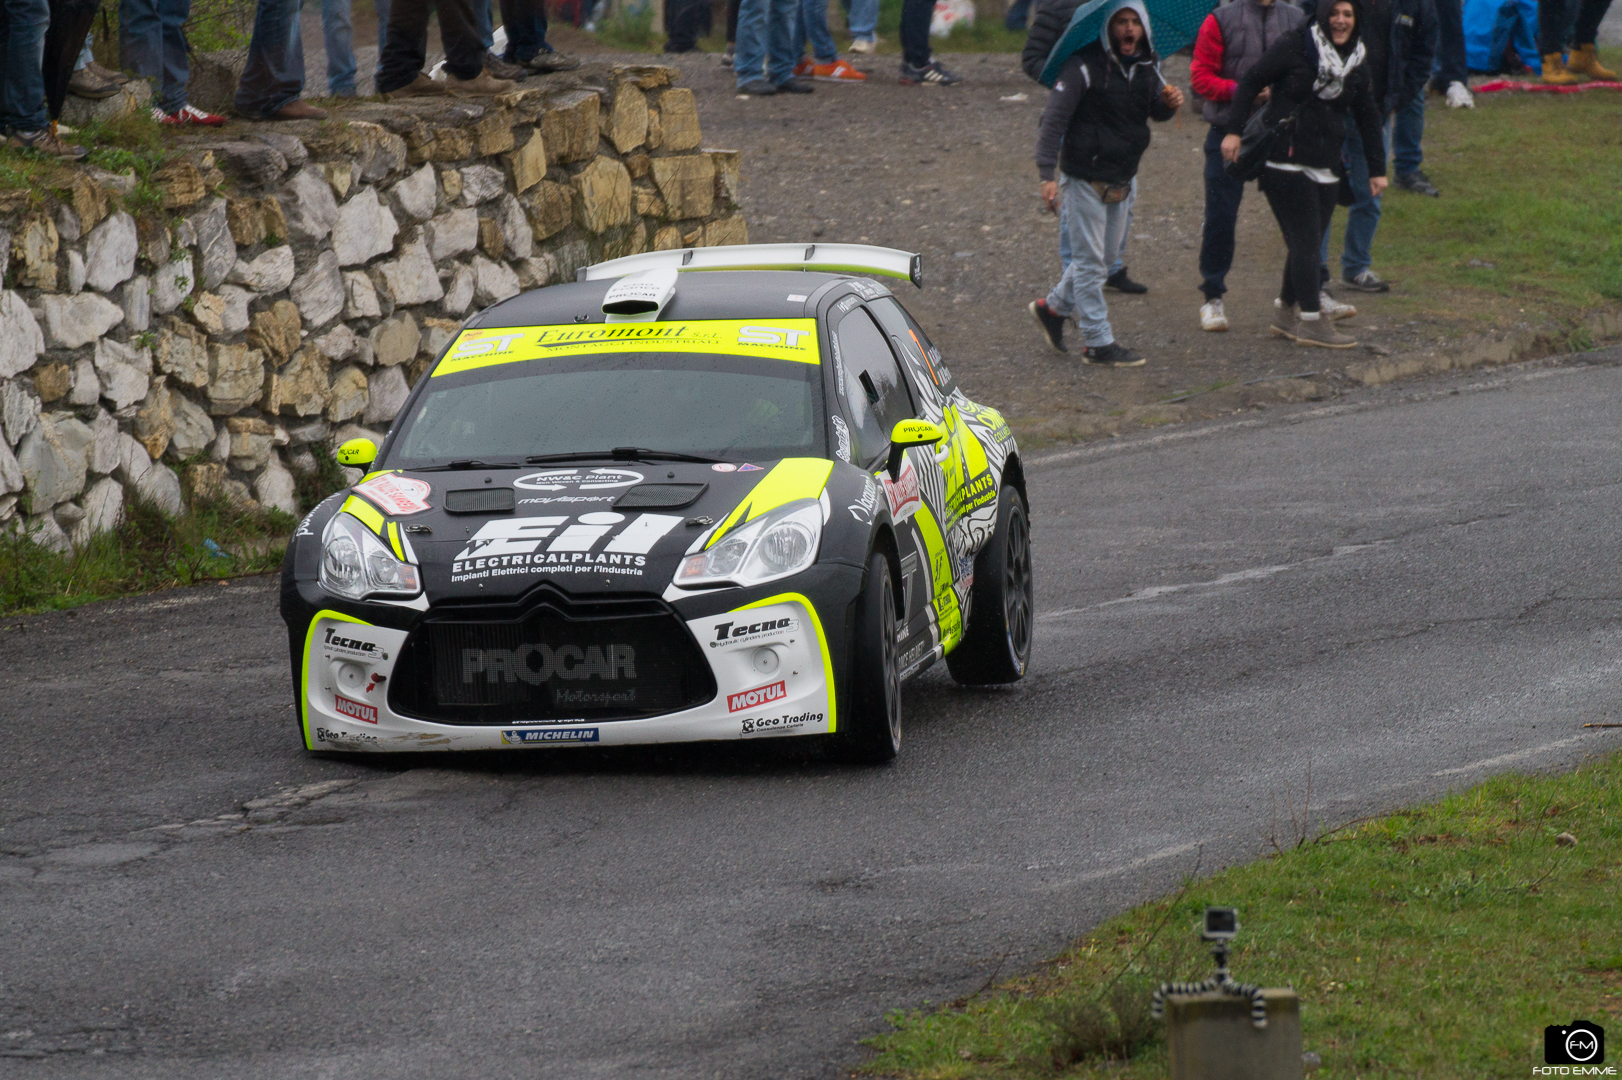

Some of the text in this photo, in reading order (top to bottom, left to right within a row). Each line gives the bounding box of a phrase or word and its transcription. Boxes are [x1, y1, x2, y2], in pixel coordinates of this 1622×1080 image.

[536, 325, 689, 343] Euromont
[737, 325, 810, 347] ST
[452, 333, 525, 359] ST
[737, 342, 806, 351] MACCHINE
[450, 350, 514, 362] MACCHINE
[452, 553, 647, 574] ELECTRICALPLANTS
[451, 564, 643, 583] Impianti Elettrici completi per l'industria
[740, 634, 760, 643] cylinders
[761, 630, 784, 639] production
[462, 643, 637, 686] PROCAR
[731, 683, 784, 711] MOTUL
[337, 697, 376, 722] MOTUL
[756, 712, 824, 727] Geo Trading
[325, 729, 339, 739] Geo
[525, 730, 594, 740] MICHELIN
